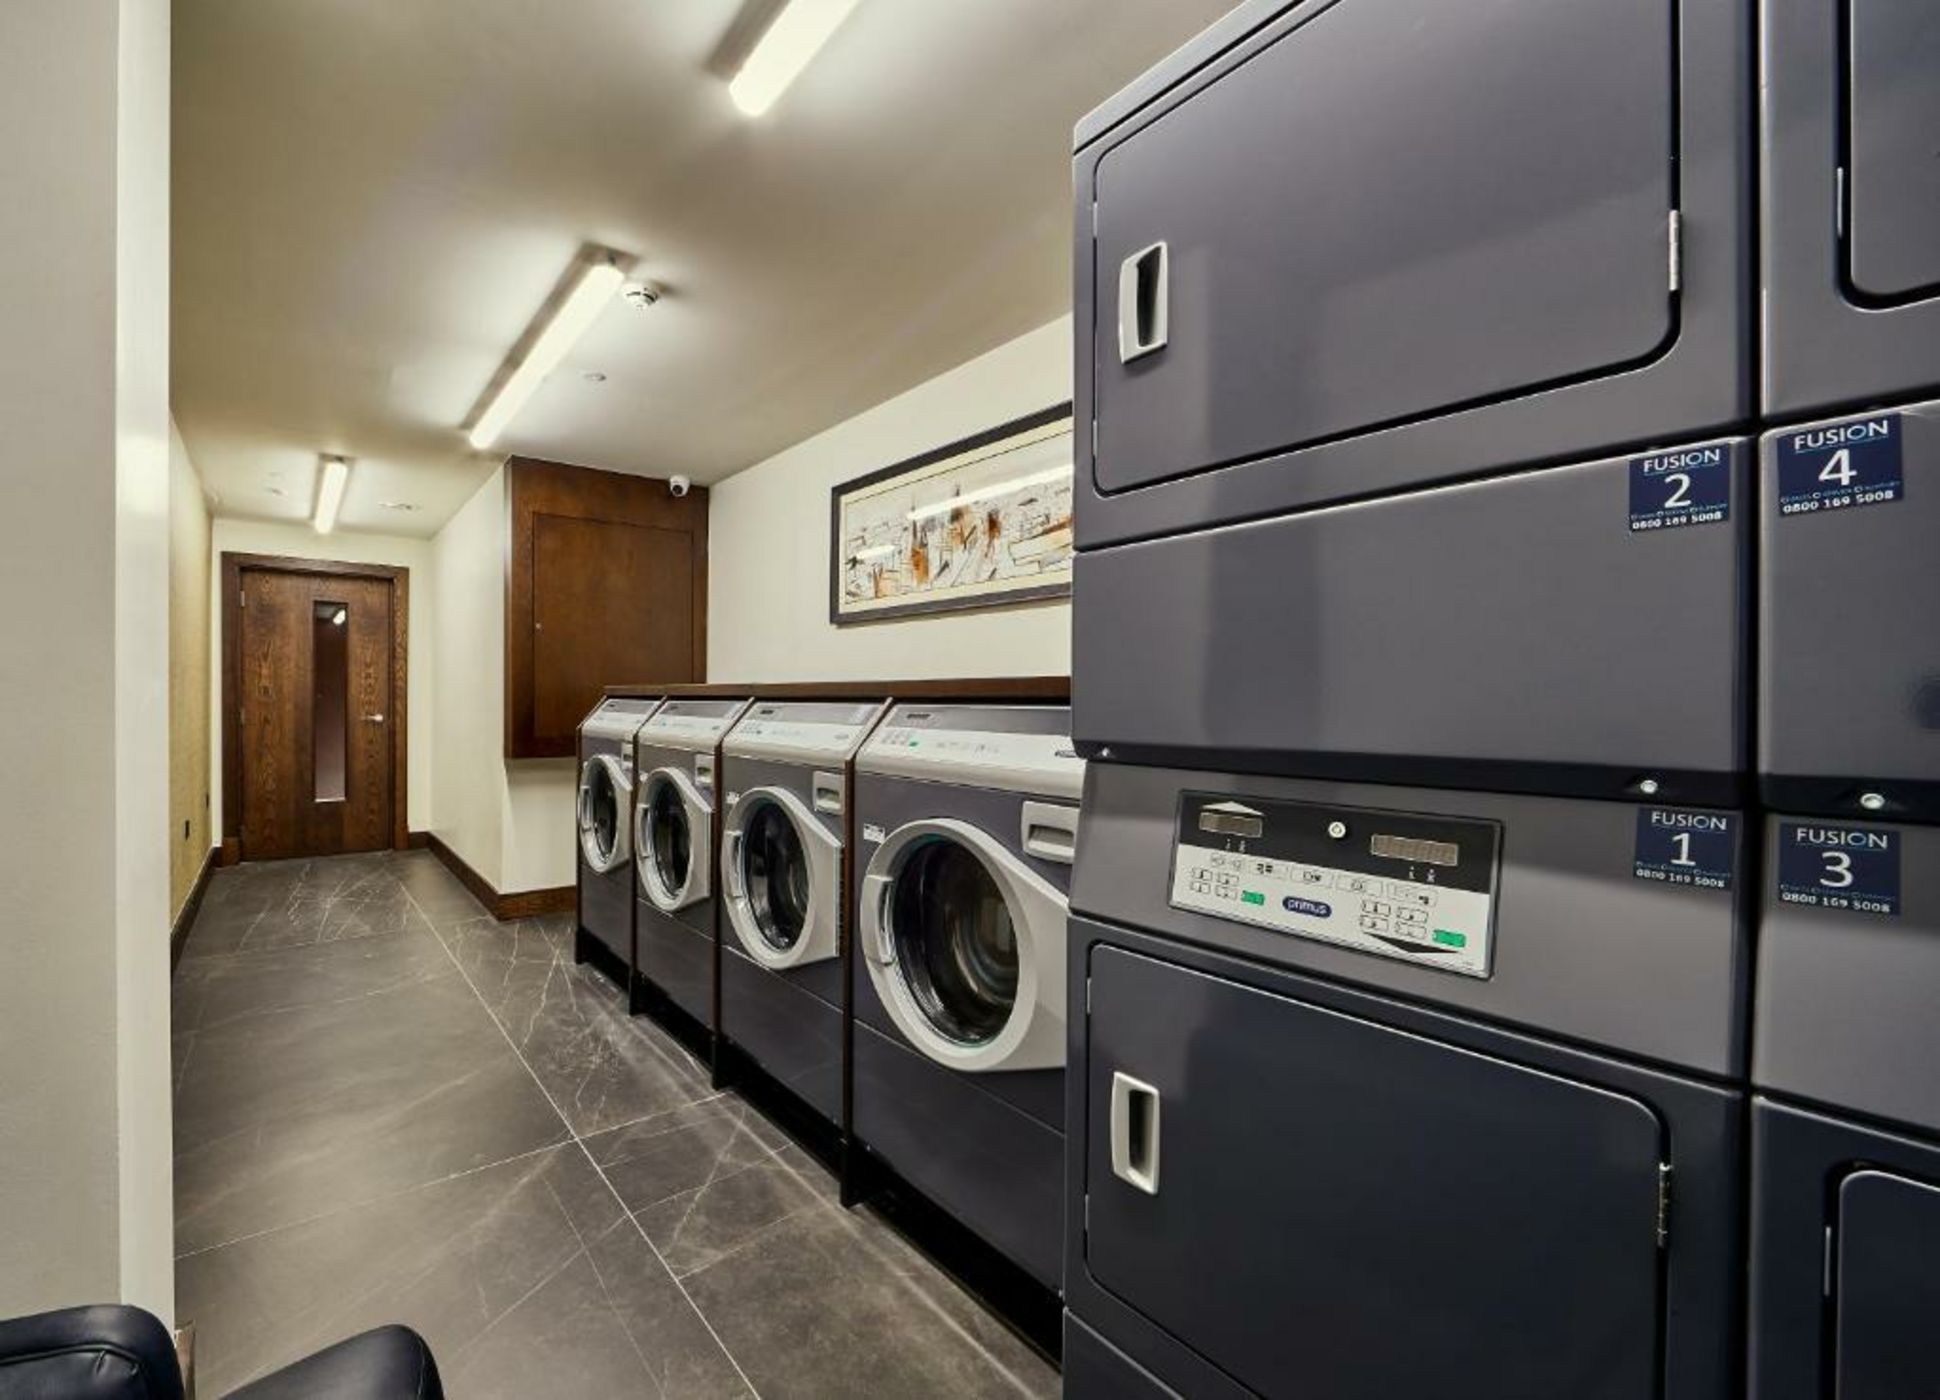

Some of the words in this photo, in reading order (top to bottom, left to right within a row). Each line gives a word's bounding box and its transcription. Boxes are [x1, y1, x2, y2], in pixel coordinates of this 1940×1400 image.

[1794, 419, 1888, 450] FUSION
[1643, 448, 1720, 473] FUSION
[1818, 448, 1858, 486] 4
[1664, 473, 1692, 508] 2
[1651, 810, 1727, 831] FUSION
[1670, 832, 1696, 866] 1
[1796, 827, 1888, 850] FUSION
[1819, 850, 1854, 887] 3
[1287, 899, 1328, 914] primus
